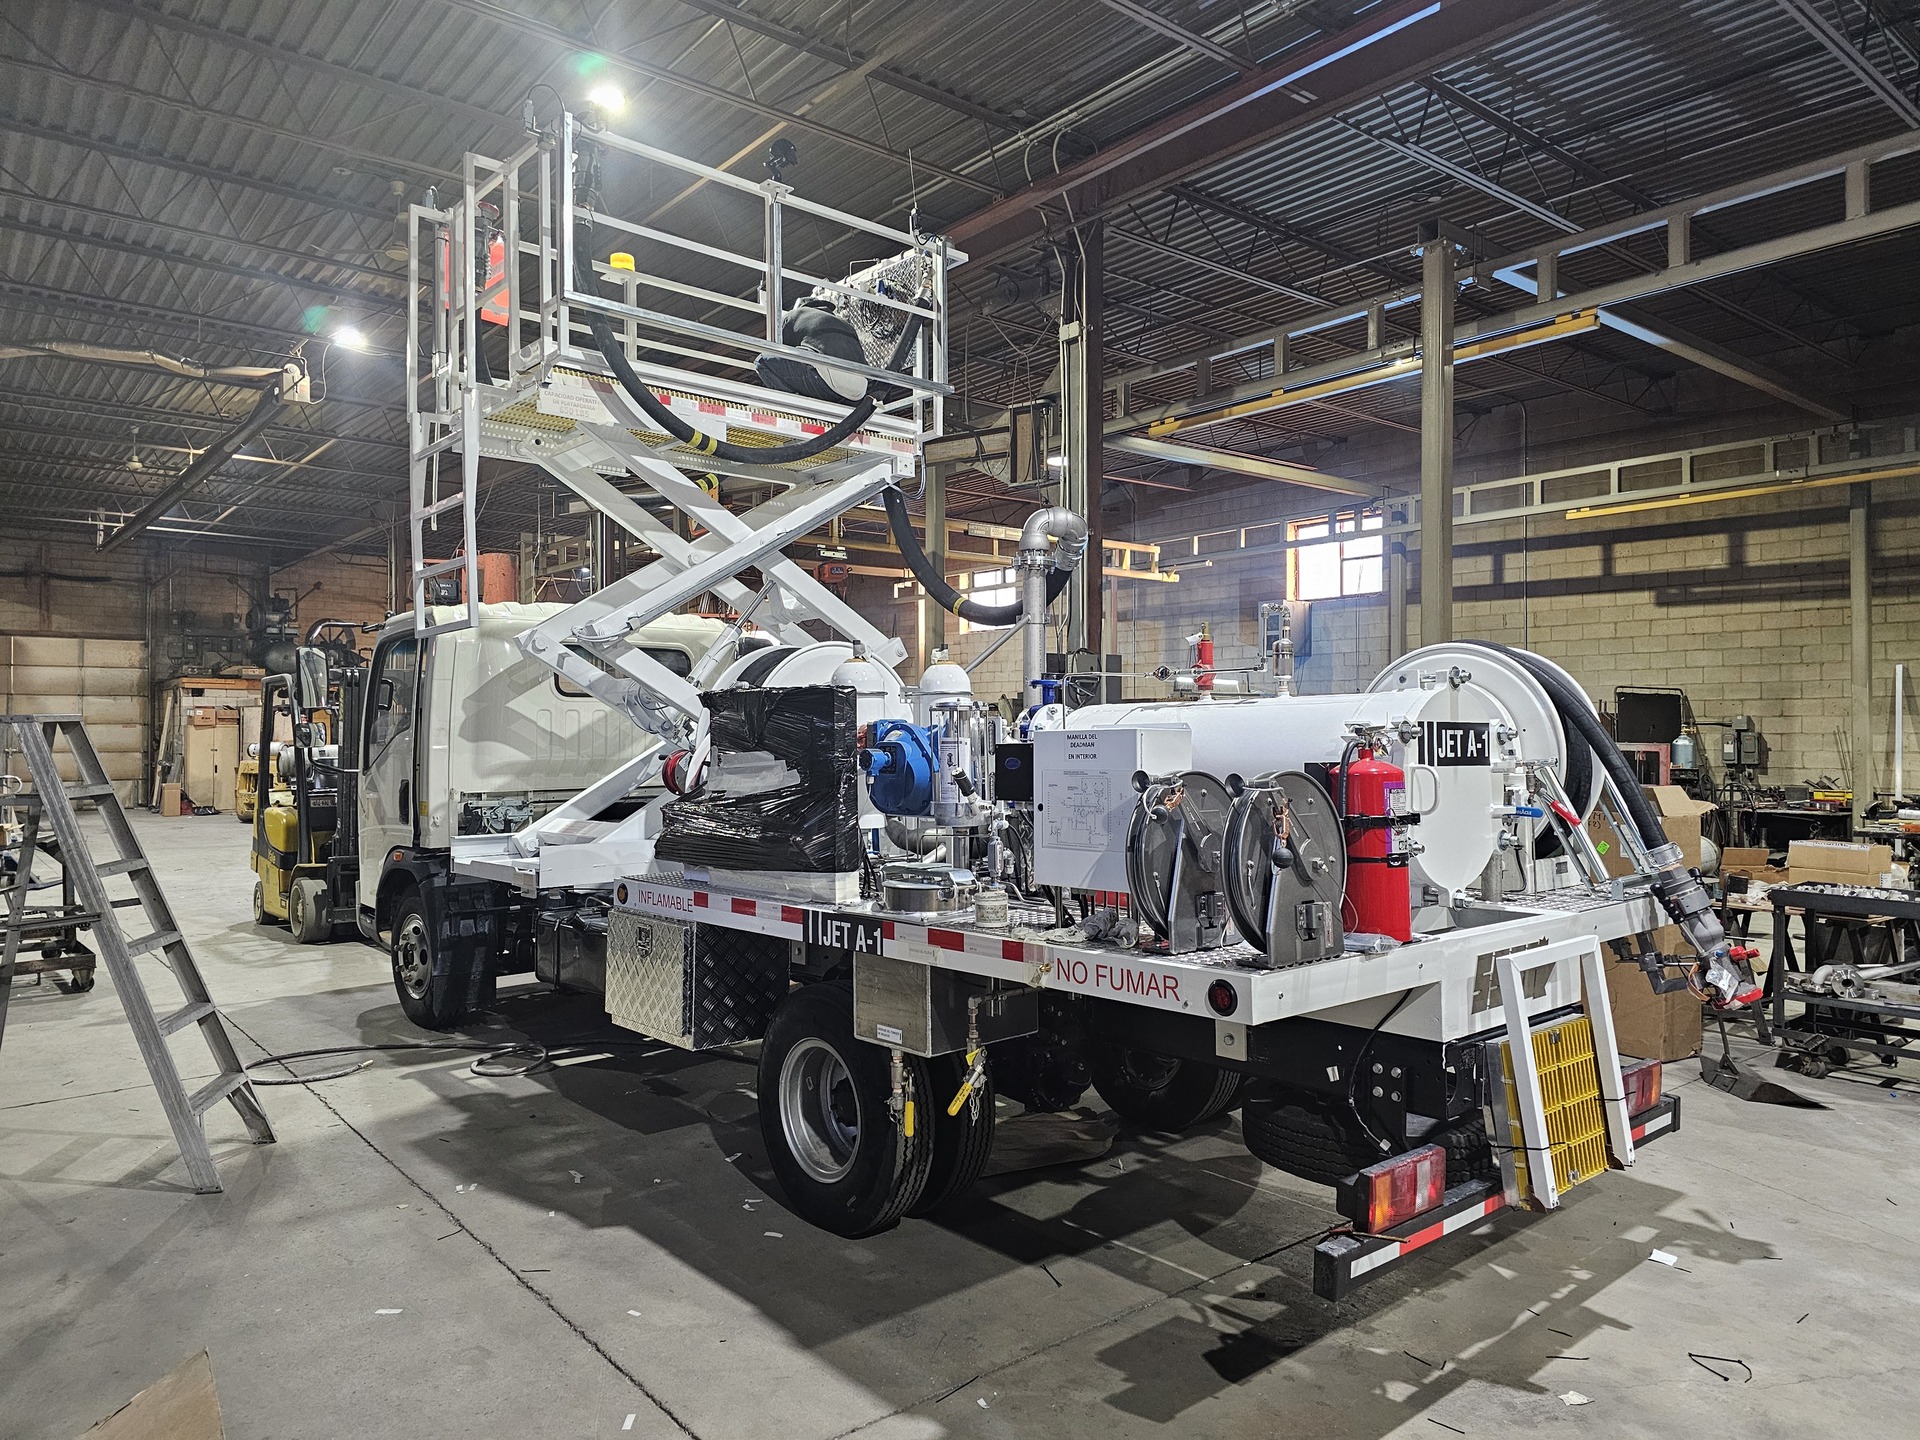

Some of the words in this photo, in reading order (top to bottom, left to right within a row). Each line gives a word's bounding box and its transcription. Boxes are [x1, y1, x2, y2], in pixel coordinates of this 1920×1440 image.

[544, 390, 575, 401] CAPACIDAD
[575, 396, 600, 405] OPERATI
[561, 400, 596, 411] PLATAFORMA
[559, 406, 574, 416] 650
[575, 409, 590, 418] LBS
[1438, 729, 1464, 758] JET
[1467, 729, 1489, 757] A-1
[638, 889, 693, 913] INFLAMABLE
[822, 919, 851, 949] JET
[855, 924, 881, 956] A-1
[1057, 957, 1088, 985] NO
[1095, 963, 1181, 1002] FUMAR
